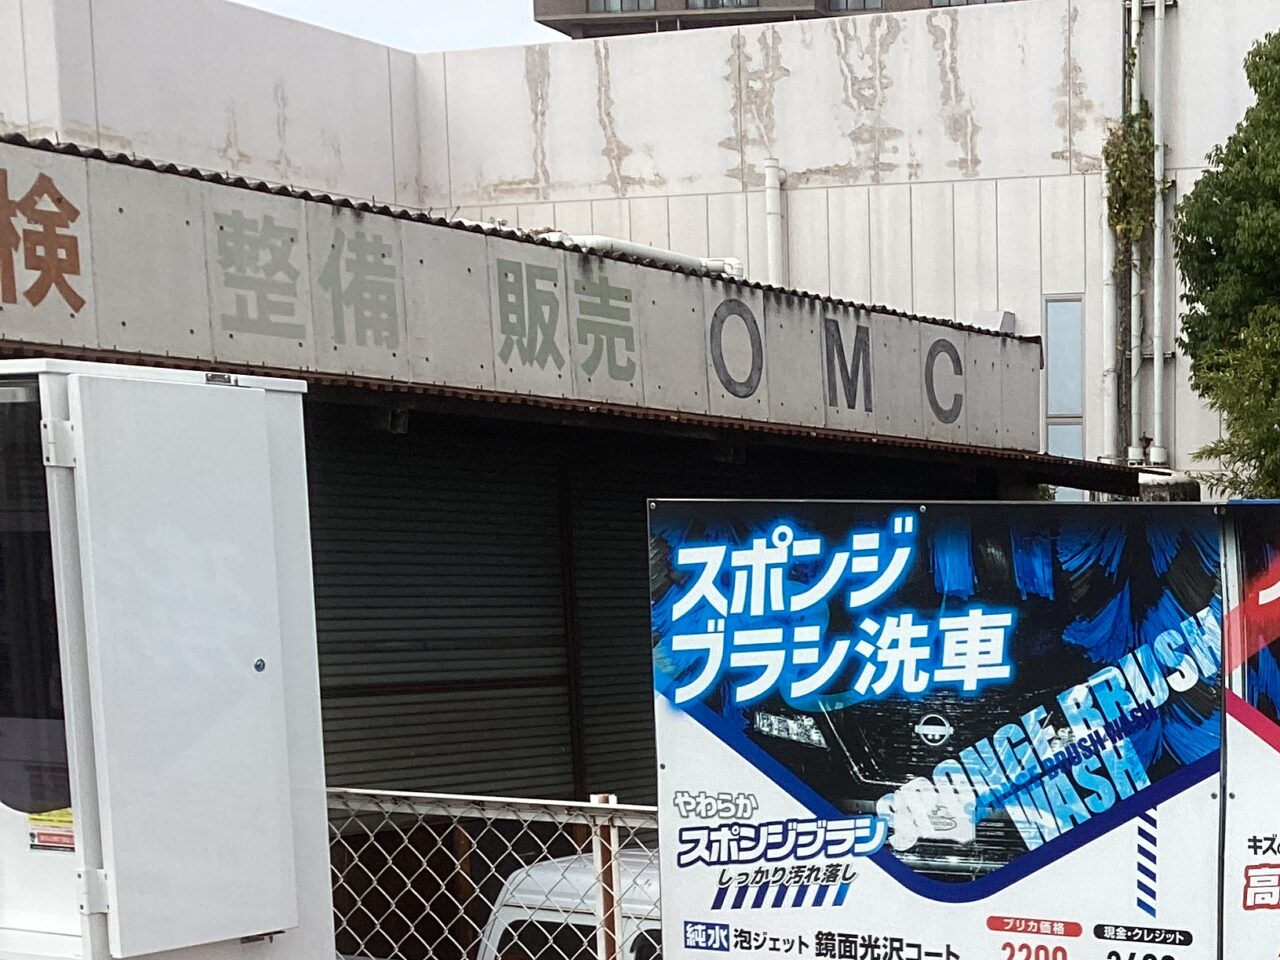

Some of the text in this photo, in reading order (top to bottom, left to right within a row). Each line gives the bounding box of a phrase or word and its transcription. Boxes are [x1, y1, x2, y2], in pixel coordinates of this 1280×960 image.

[214, 209, 401, 350] 整備
[496, 258, 637, 382] 販売
[672, 516, 912, 622] スポンジ
[671, 608, 1012, 704] ブラシ洗車
[674, 791, 758, 819] やわらか
[1004, 737, 1151, 851] WASH
[677, 815, 888, 867] スポンジブラシ
[717, 863, 857, 886] しっかり汚れ落し
[685, 922, 729, 950] 純水
[734, 928, 810, 954] 泡ジェット
[1103, 926, 1185, 944] 現金・クレジット
